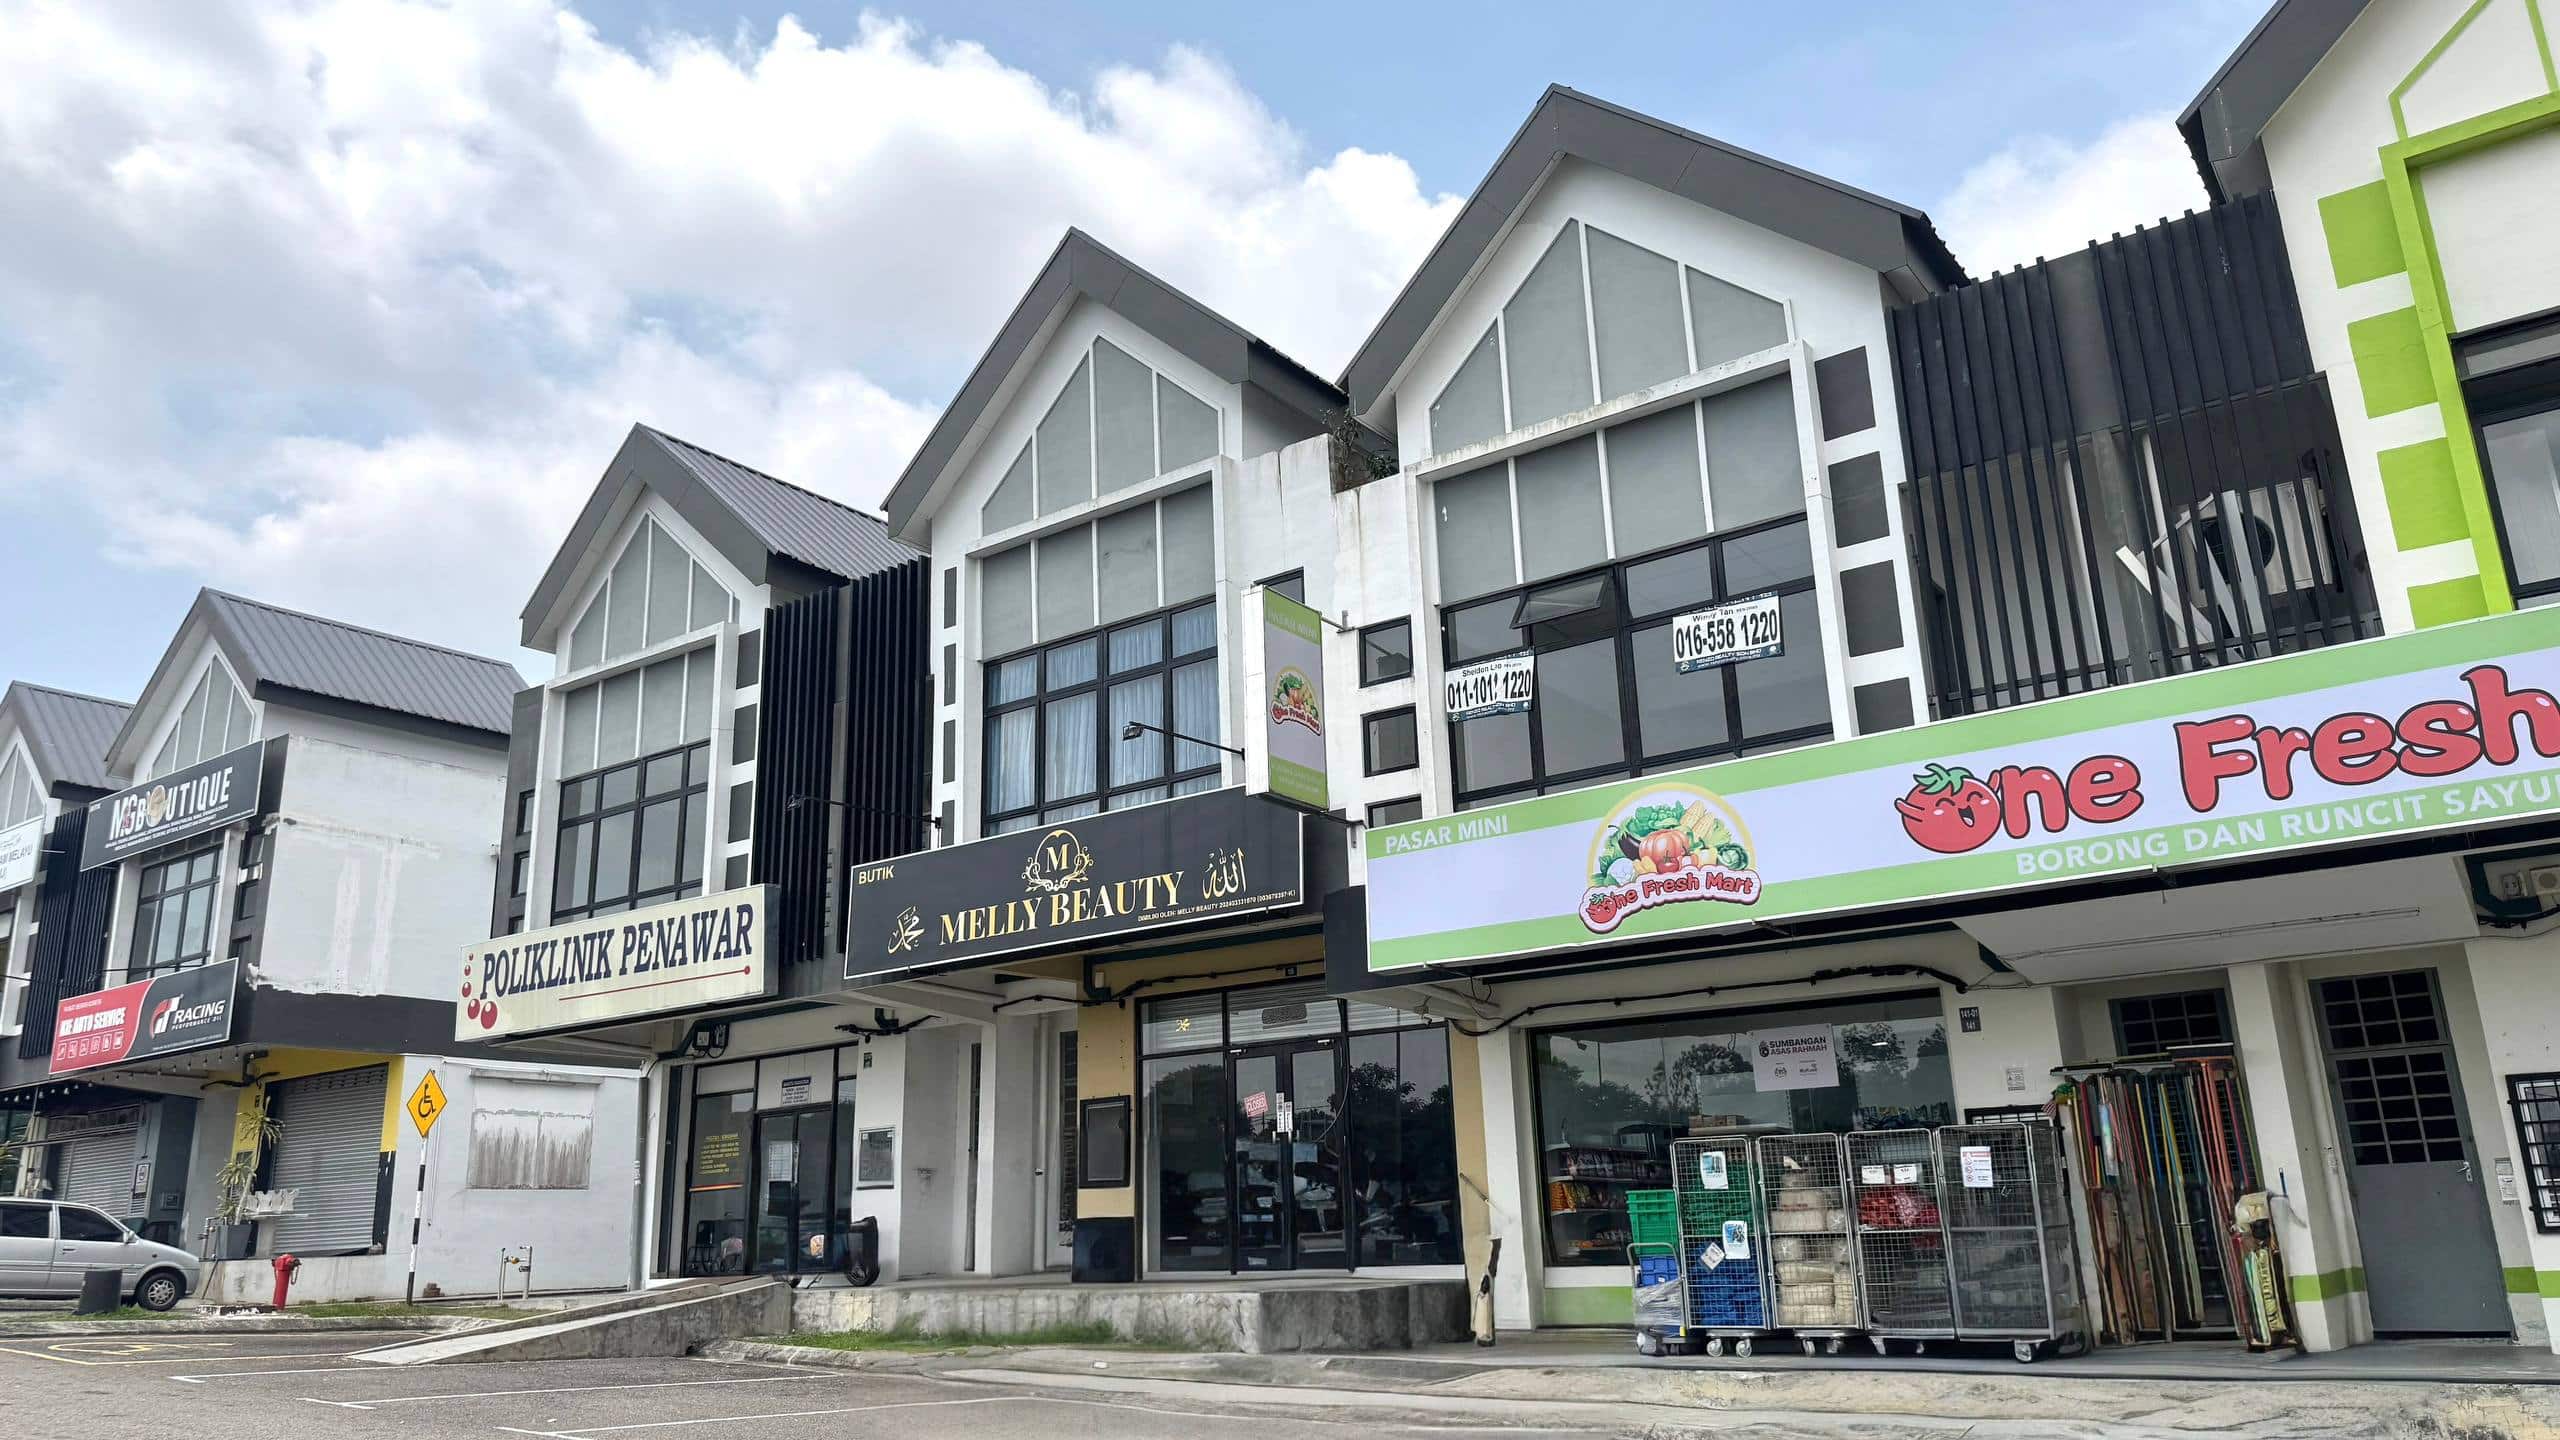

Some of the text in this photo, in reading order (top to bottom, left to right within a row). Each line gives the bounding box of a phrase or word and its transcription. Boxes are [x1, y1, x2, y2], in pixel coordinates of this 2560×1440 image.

[1676, 609, 1777, 659] 016-558 1220
[1462, 666, 1489, 677] Sheldon
[1503, 669, 1531, 699] 1220
[2174, 664, 2560, 812] Fresh
[1385, 815, 1509, 854] PASAR MINI
[2016, 774, 2560, 875] BORONG DAN RUNCIT SAYU
[858, 865, 895, 885] BUTIK
[1642, 872, 1700, 899] Fresh
[1706, 872, 1753, 894] Mart
[939, 871, 1184, 946] MELLY BEAUTY
[1177, 906, 1195, 915] MELLY
[480, 903, 754, 1000] POLIKLINIK PENAWAR
[173, 1000, 226, 1025] RACING
[1769, 1036, 1826, 1049] SUMBANGAN
[1771, 1043, 1828, 1055] ASAS RAHMAH
